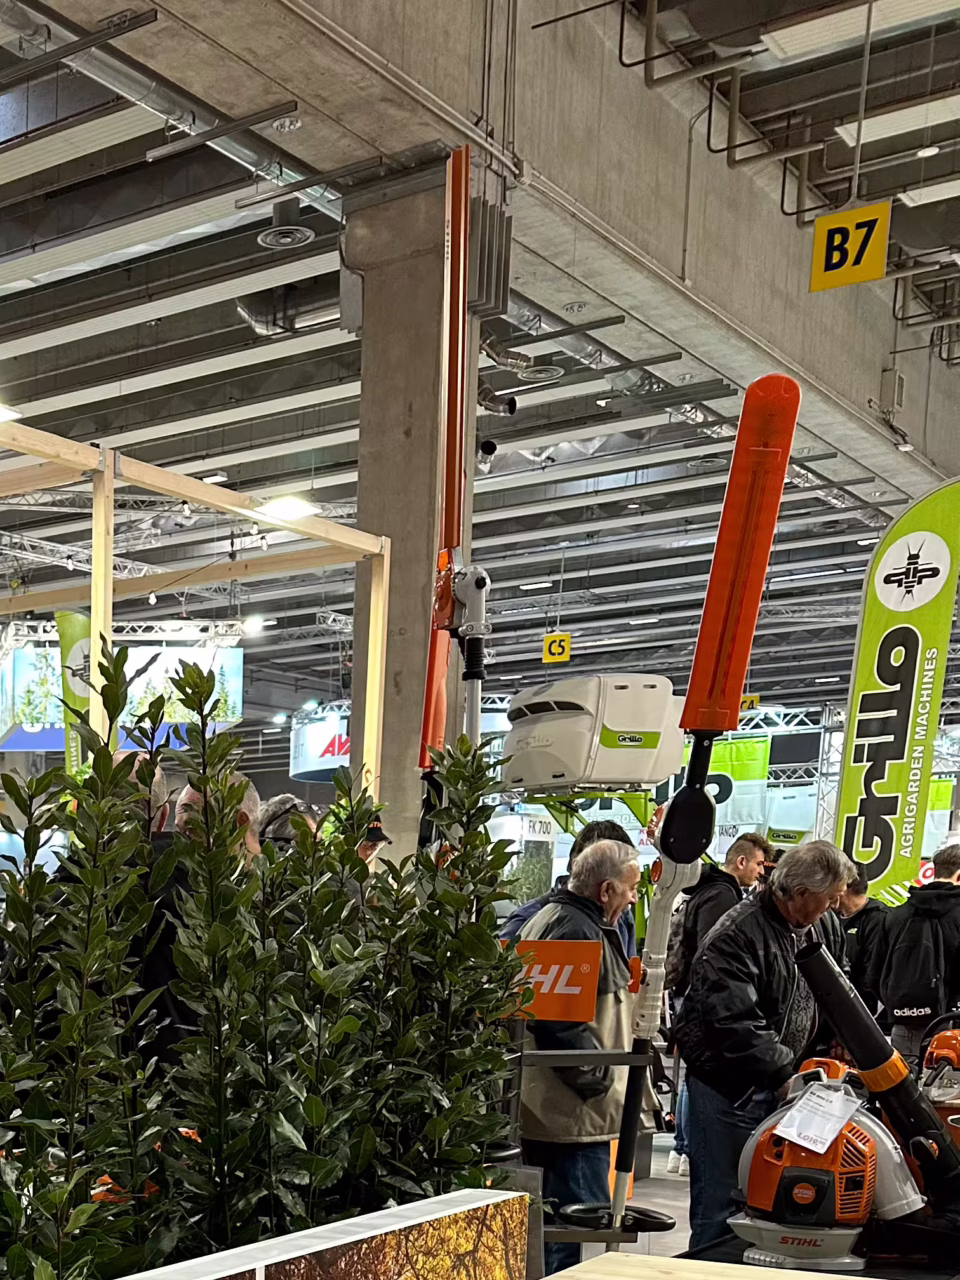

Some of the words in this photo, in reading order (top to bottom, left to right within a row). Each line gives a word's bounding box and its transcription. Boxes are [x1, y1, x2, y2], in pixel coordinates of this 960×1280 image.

[824, 217, 880, 273] B7
[548, 638, 566, 656] C5
[617, 734, 643, 743] Grillo
[840, 624, 922, 885] Grillo
[900, 745, 925, 859] AGRIGARDEN
[913, 647, 938, 740] MACHINES
[528, 819, 538, 834] FK
[538, 820, 552, 835] 700
[771, 832, 797, 840] Grillo
[893, 1007, 932, 1017] adidas
[779, 1236, 822, 1248] STIHL
